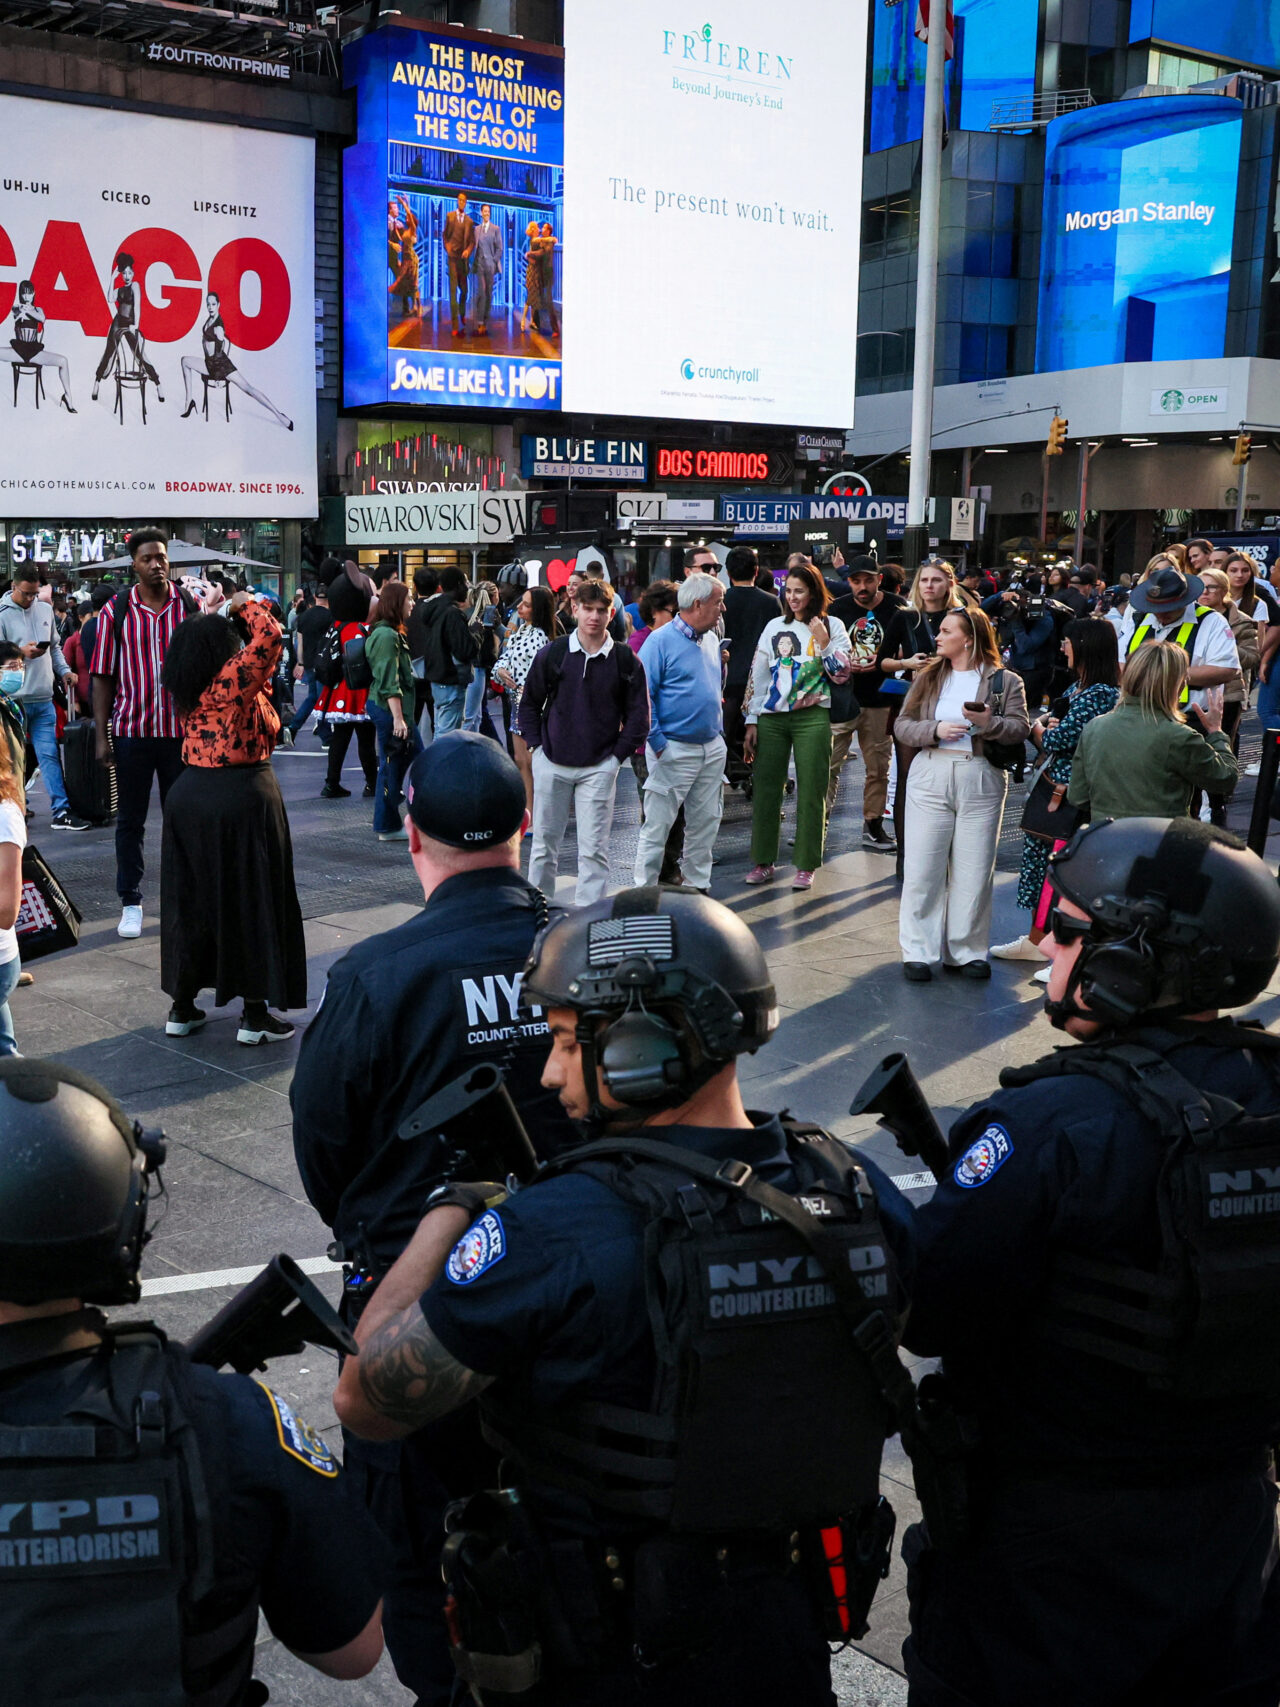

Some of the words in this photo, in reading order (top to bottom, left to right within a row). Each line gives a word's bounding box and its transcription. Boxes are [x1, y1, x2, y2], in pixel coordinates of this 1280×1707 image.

[148, 42, 291, 79] #OUTFRONTPRIME
[429, 43, 464, 70] THE
[471, 51, 524, 81] MOST
[663, 29, 793, 80] FRIEREN
[391, 61, 562, 111] AWARD-WINNING
[672, 77, 711, 97] Beyond
[714, 82, 761, 108] Journey's
[763, 96, 783, 110] End
[417, 90, 504, 124] MUSICAL
[510, 106, 535, 130] OF
[414, 113, 449, 140] THE
[455, 121, 537, 154] SEASON!
[4, 179, 50, 194] UH-UH
[102, 190, 151, 205] CICERO
[194, 201, 257, 218] LIPSCHITZ
[609, 178, 646, 203] The
[655, 186, 728, 217] present
[736, 200, 785, 225] won't
[793, 210, 835, 233] wait.
[1065, 207, 1138, 232] Morgan
[1141, 201, 1215, 226] Stanley
[390, 358, 445, 391] SOME
[509, 365, 560, 400] HOT
[698, 366, 759, 384] crunchyroll
[1187, 394, 1218, 404] OPEN
[535, 437, 595, 462] BLUE
[607, 441, 644, 464] FIN
[659, 449, 692, 477] DOS
[696, 450, 768, 480] CAMINOS
[536, 464, 593, 476] SEAFOOD
[608, 467, 644, 478] SUSHI
[1, 480, 156, 490] CHICAGOTHEMUSICAL.COM
[165, 482, 235, 493] BROADWAY.
[240, 483, 275, 494] SINCE
[275, 484, 305, 495] 1996.
[348, 503, 475, 534] SWAROVSKI
[726, 503, 769, 522] BLUE
[774, 504, 801, 522] FIN
[810, 501, 861, 519] NOW
[866, 502, 909, 524] OPE
[12, 534, 104, 563] SLAM
[804, 531, 829, 541] HOPE
[462, 972, 543, 1027] NY
[479, 1214, 502, 1262] POLICE
